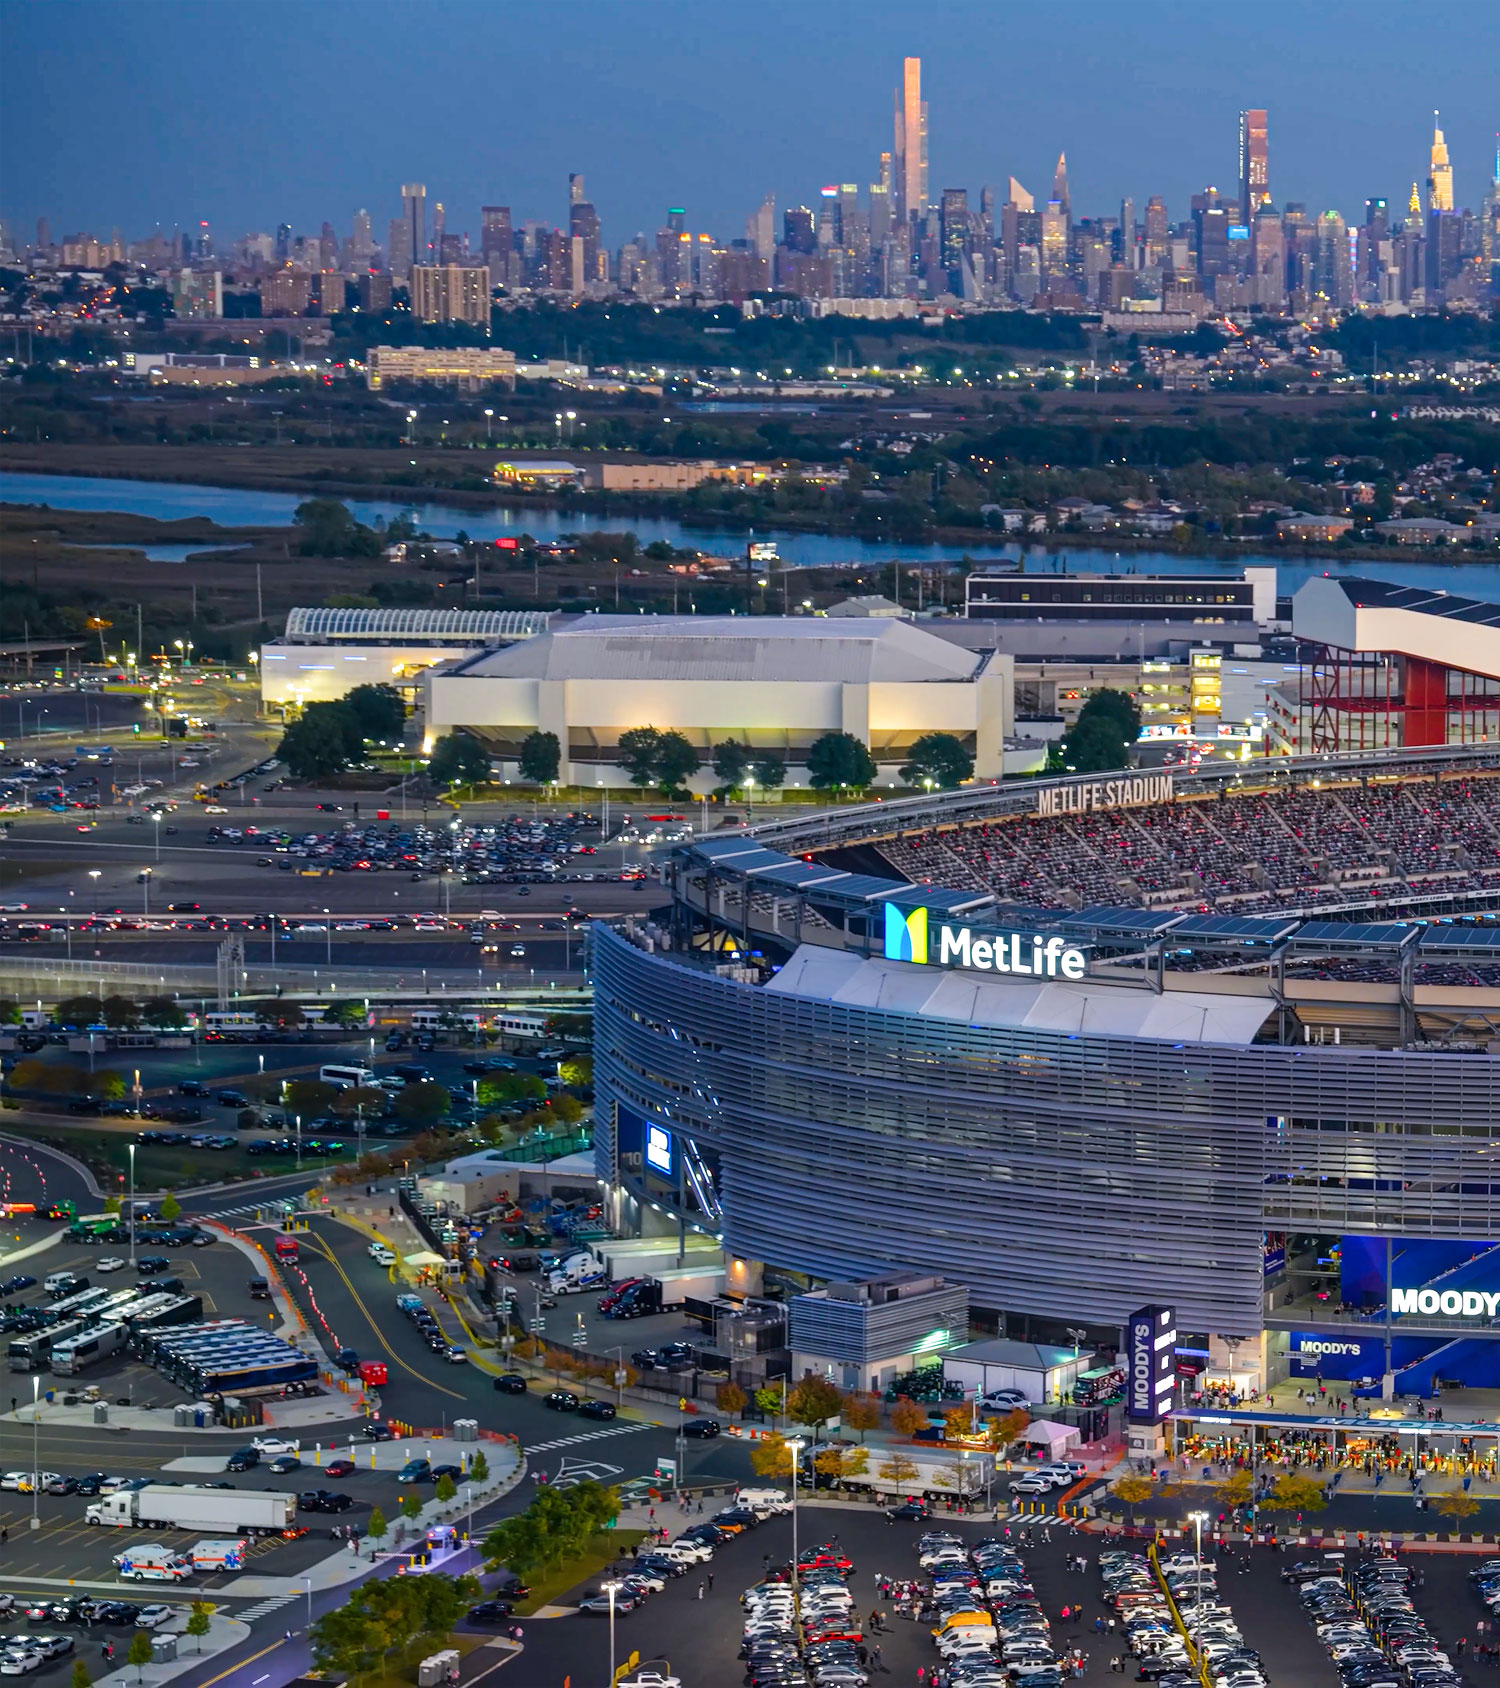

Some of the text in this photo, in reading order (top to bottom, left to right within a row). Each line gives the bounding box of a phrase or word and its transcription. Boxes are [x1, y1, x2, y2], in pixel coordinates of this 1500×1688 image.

[1039, 776, 1173, 815] METLIFE STADIUM
[940, 926, 1086, 979] MetLife
[1134, 1323, 1150, 1410] MOODY'S
[1300, 1340, 1361, 1356] MOODY'S
